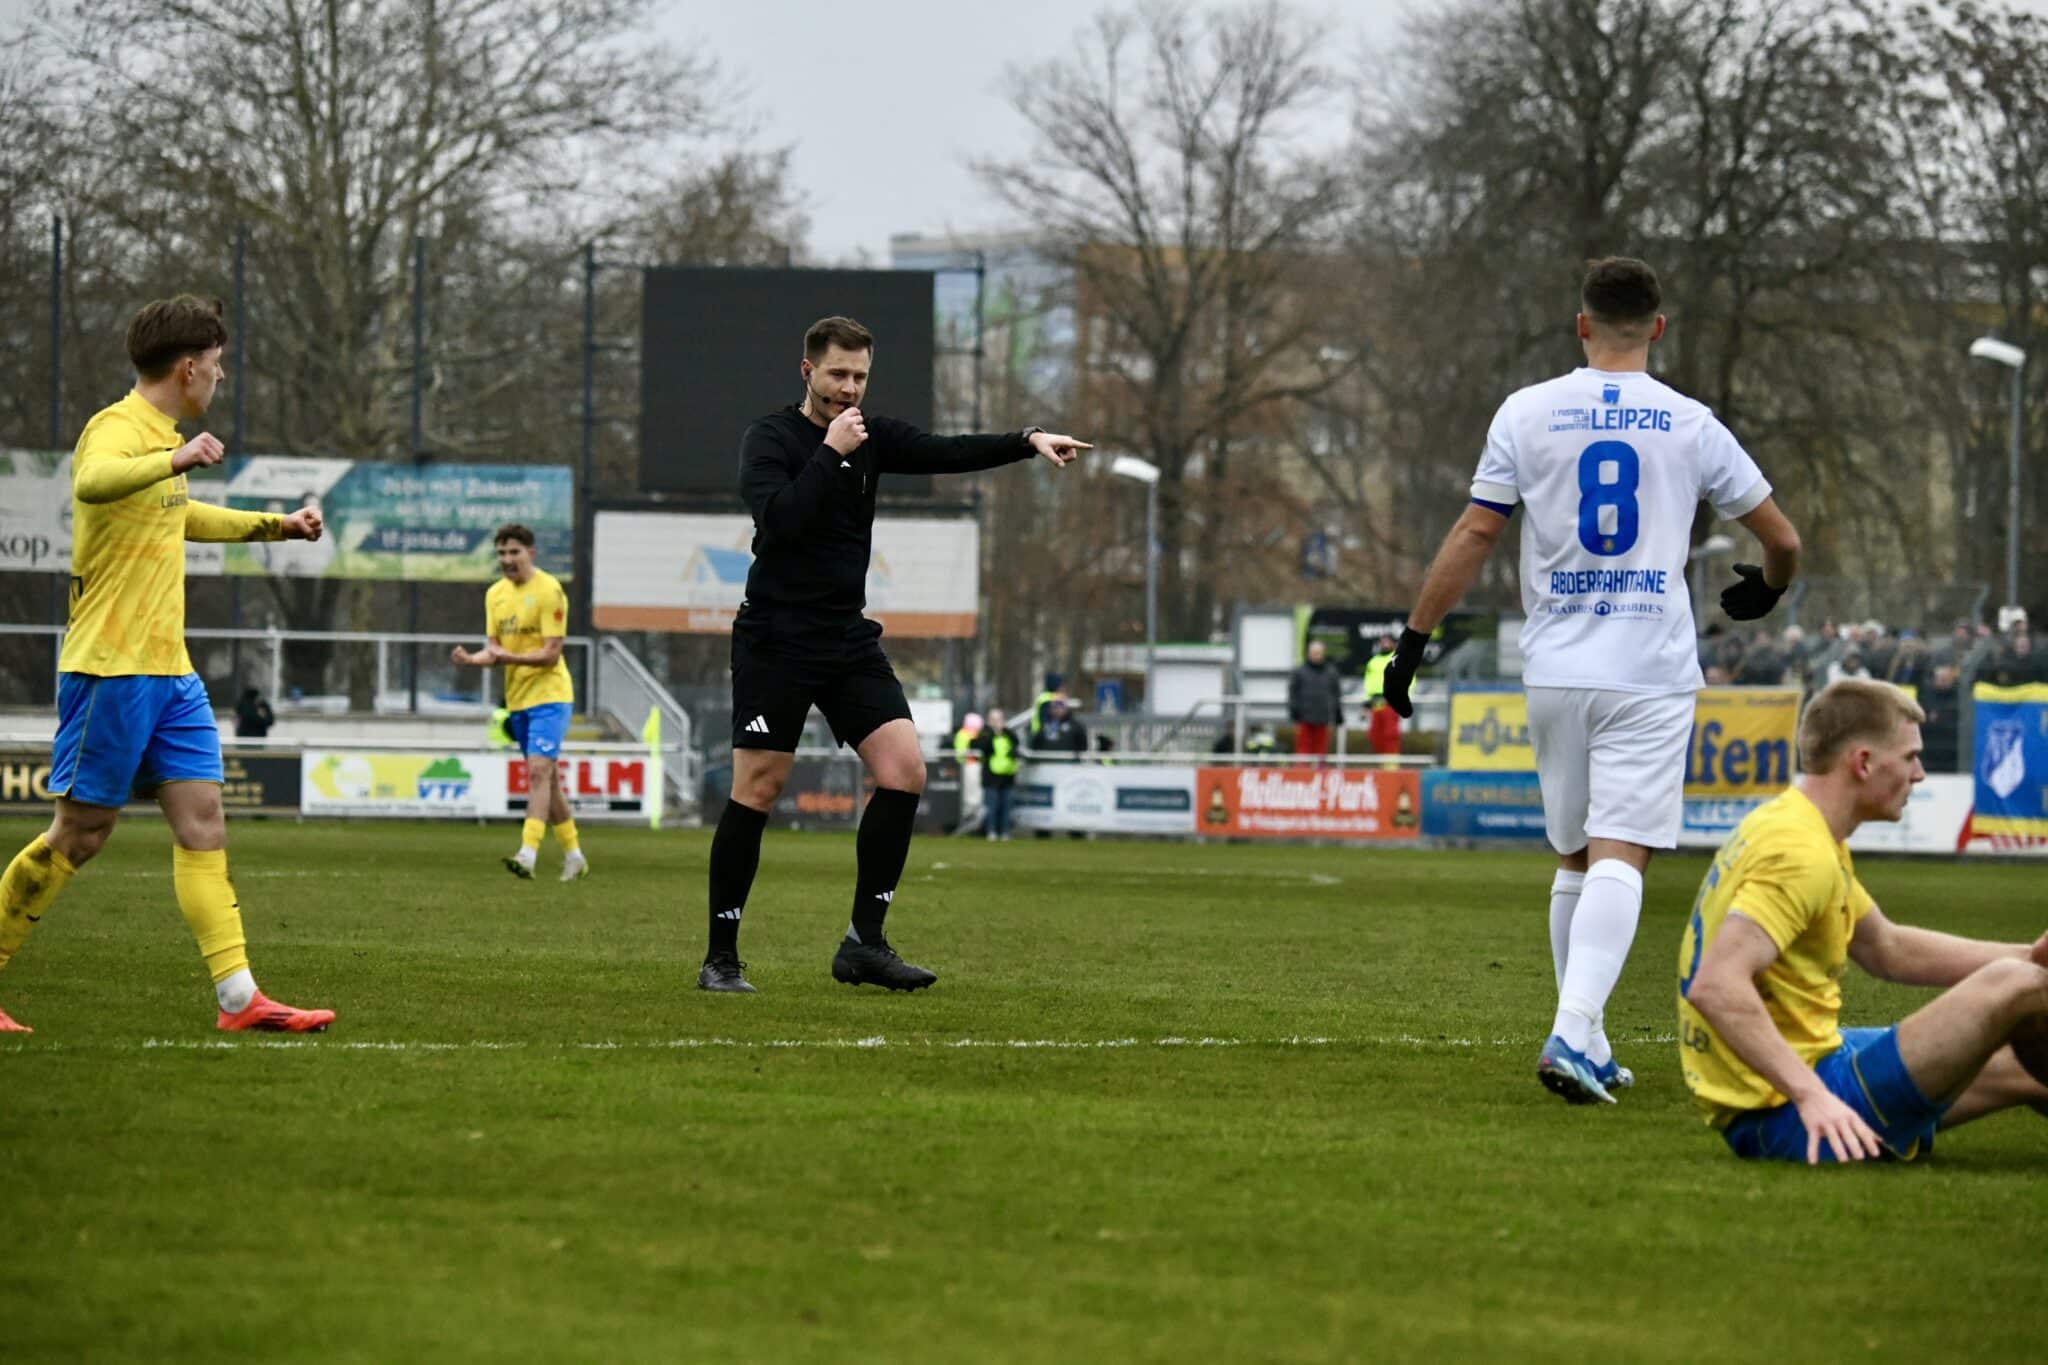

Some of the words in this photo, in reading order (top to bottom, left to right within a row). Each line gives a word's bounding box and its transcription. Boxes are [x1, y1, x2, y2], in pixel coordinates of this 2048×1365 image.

[1591, 408, 1672, 432] LEIPZIG
[1578, 440, 1639, 556] 8
[1550, 569, 1667, 594] ABDERRAHMANE
[0, 764, 51, 800] HO
[417, 783, 469, 799] VTF
